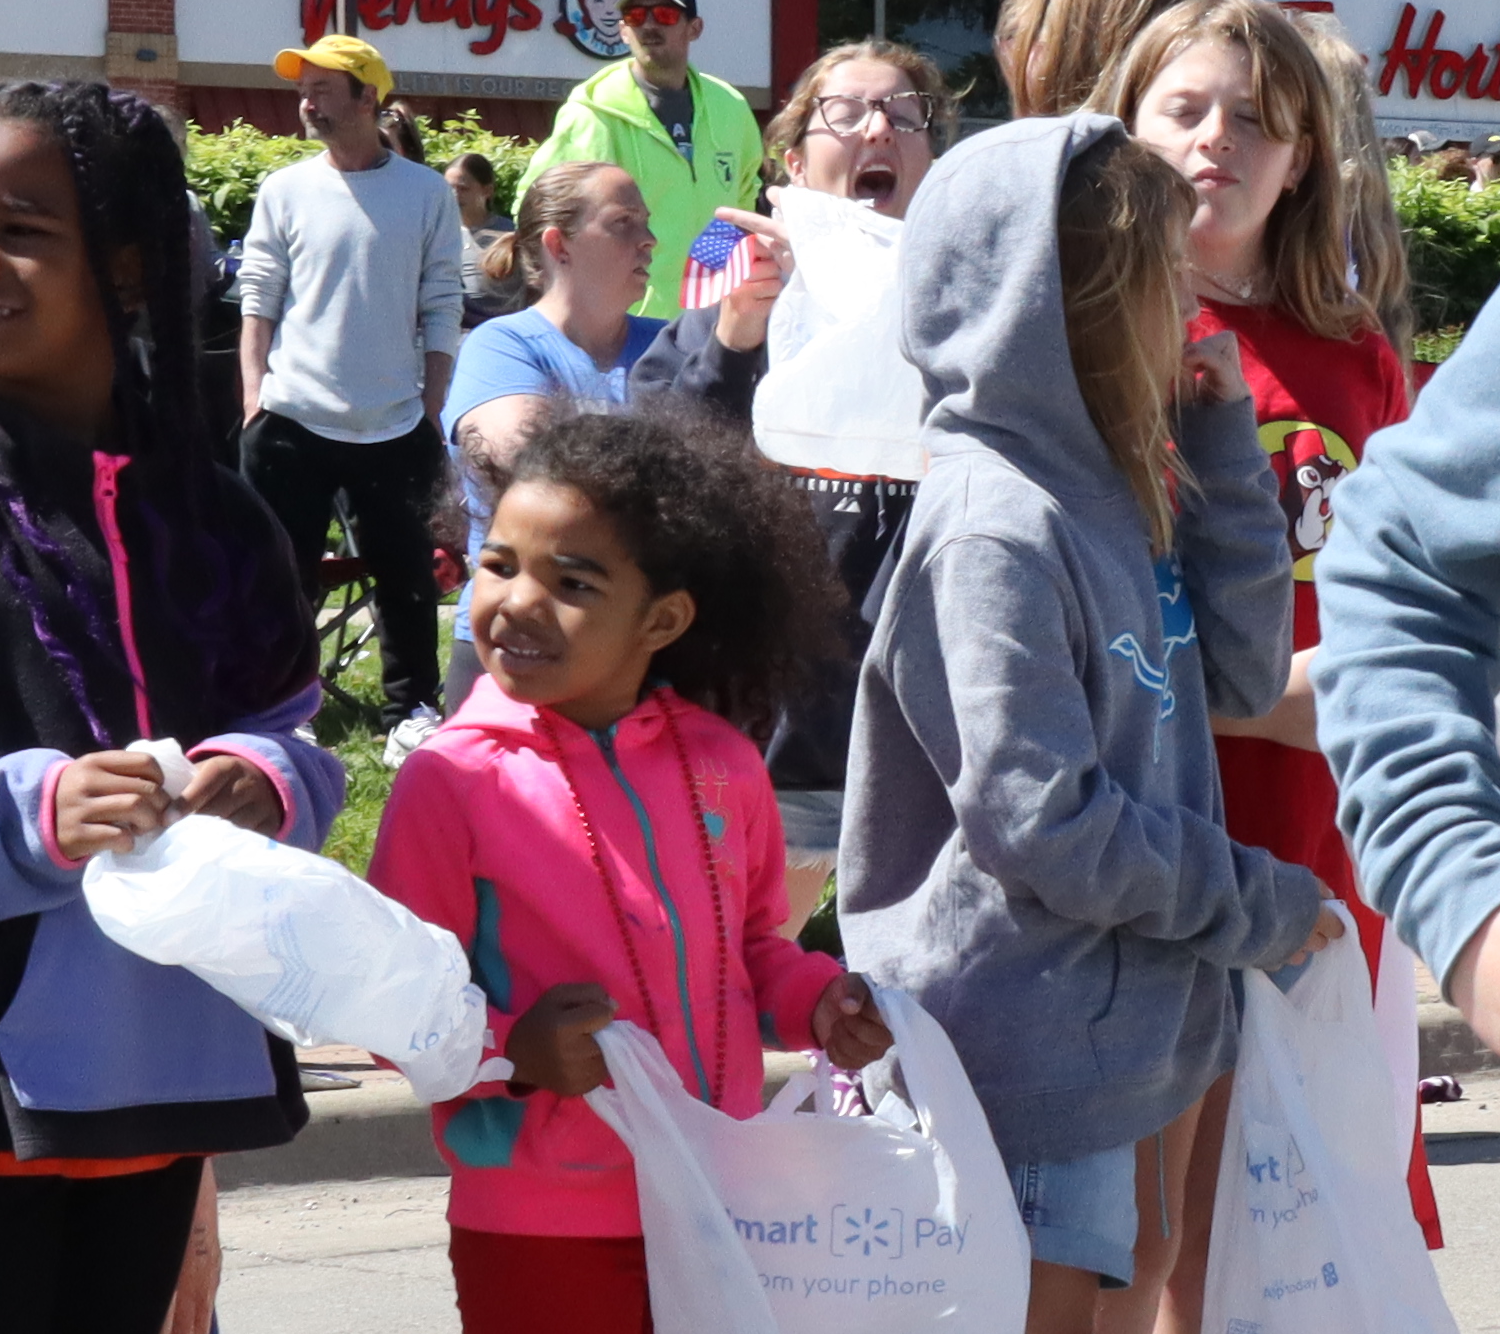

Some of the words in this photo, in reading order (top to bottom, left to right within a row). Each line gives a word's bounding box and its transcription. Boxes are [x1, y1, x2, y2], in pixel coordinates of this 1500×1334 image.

[400, 73, 446, 94] LITY
[481, 78, 527, 95] OUR
[915, 1217, 970, 1255] Pay
[758, 1274, 793, 1292] om
[803, 1277, 859, 1298] your
[867, 1274, 947, 1302] phone
